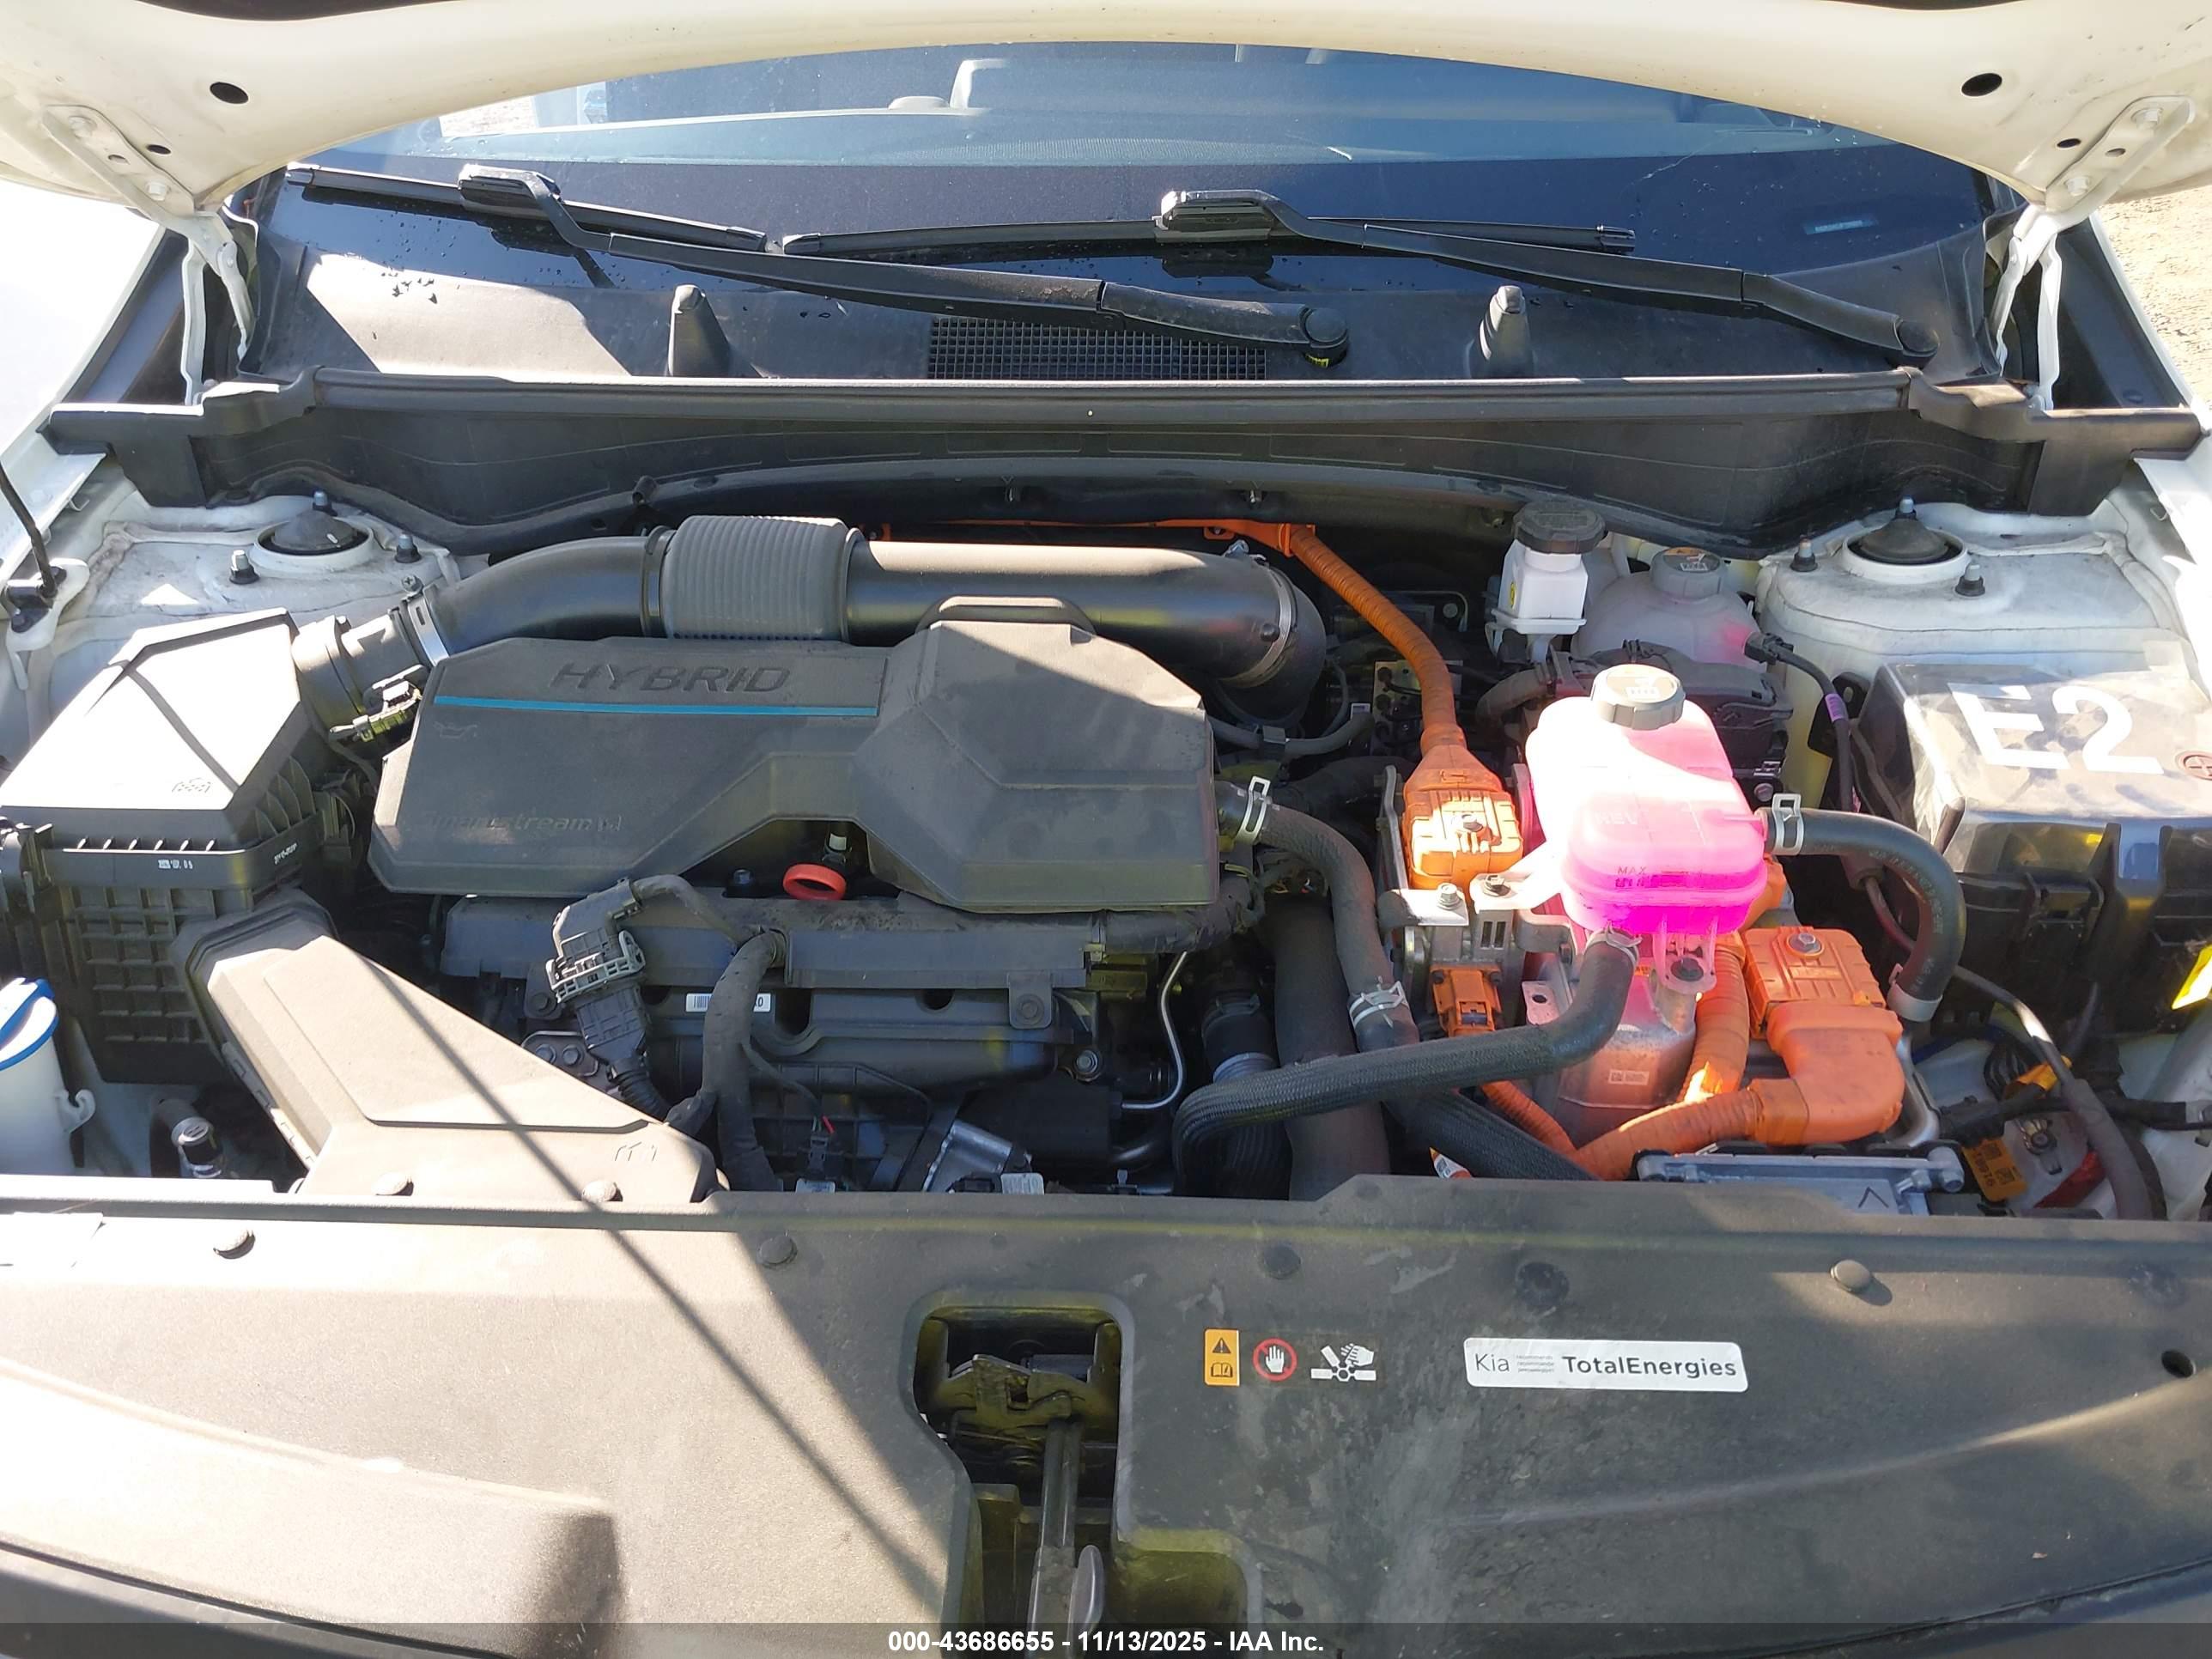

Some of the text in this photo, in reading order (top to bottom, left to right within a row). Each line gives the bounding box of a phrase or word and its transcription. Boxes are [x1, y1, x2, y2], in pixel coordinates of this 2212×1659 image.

[550, 663, 791, 692] HYBRID
[1947, 685, 2165, 775] E2
[1617, 866, 1647, 877] MAX
[1474, 1353, 1510, 1373] Kia
[1562, 1356, 1737, 1379] TotalEnergies
